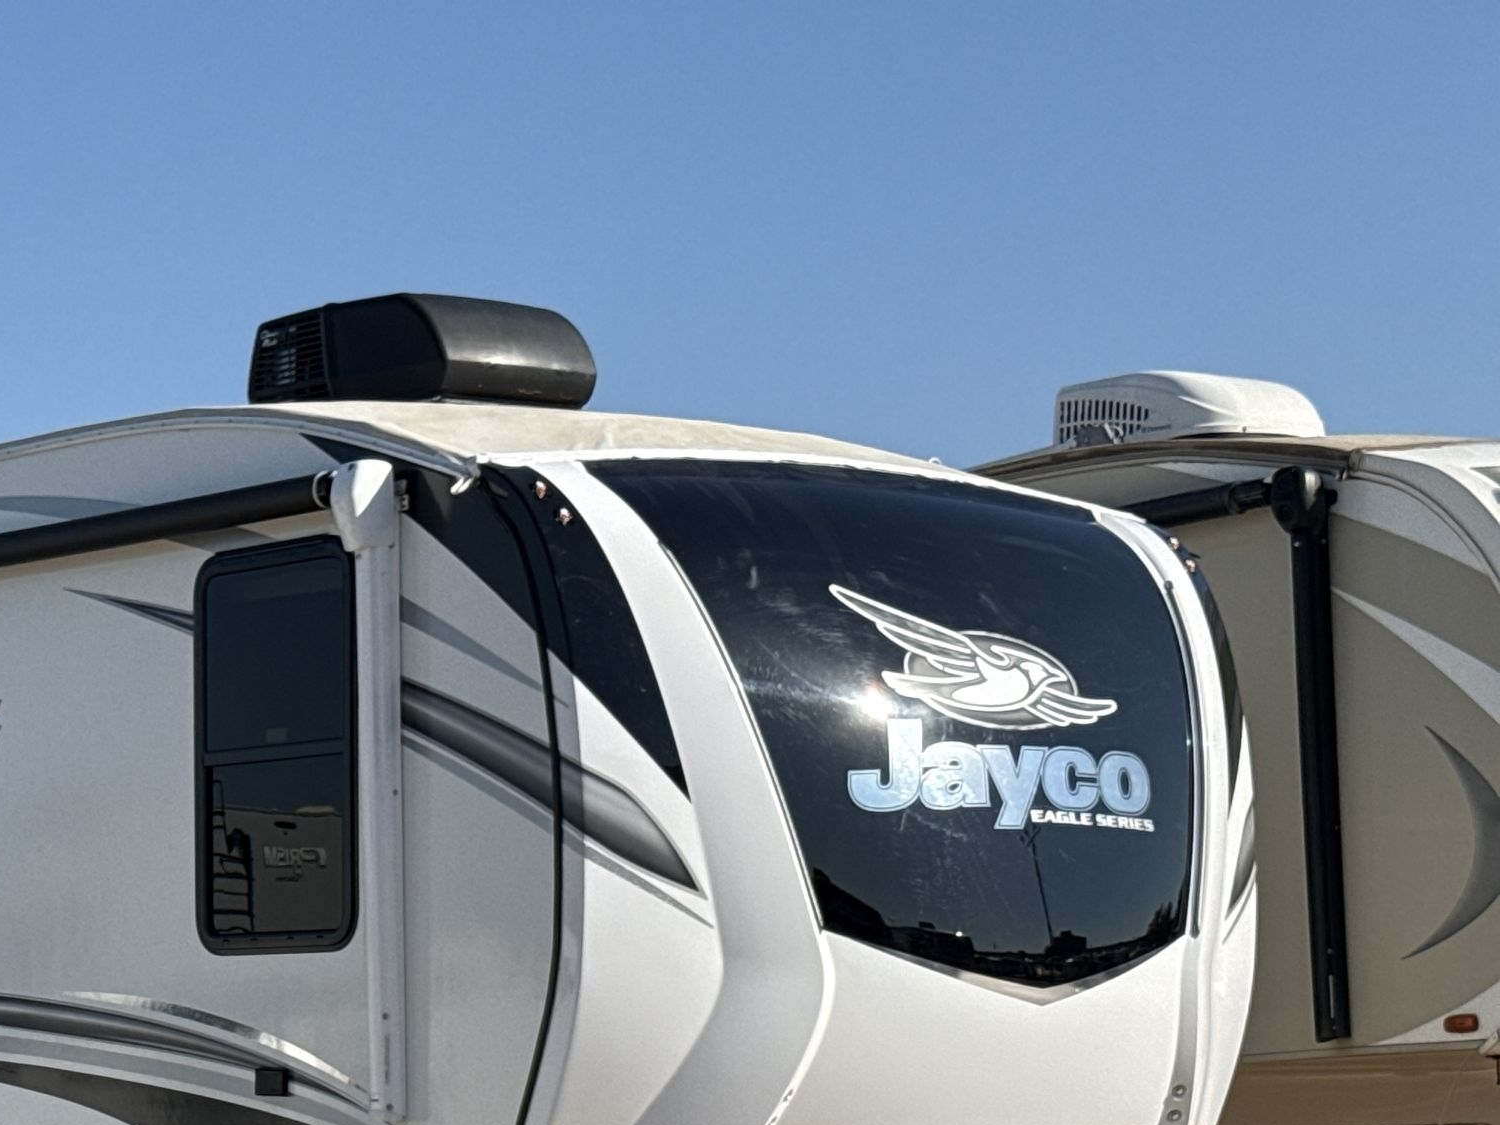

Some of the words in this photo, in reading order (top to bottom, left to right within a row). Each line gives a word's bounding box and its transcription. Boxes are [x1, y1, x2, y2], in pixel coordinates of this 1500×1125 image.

[847, 718, 1152, 830] Jayco
[1030, 809, 1093, 826] EAGLE
[1095, 813, 1155, 832] SERIES
